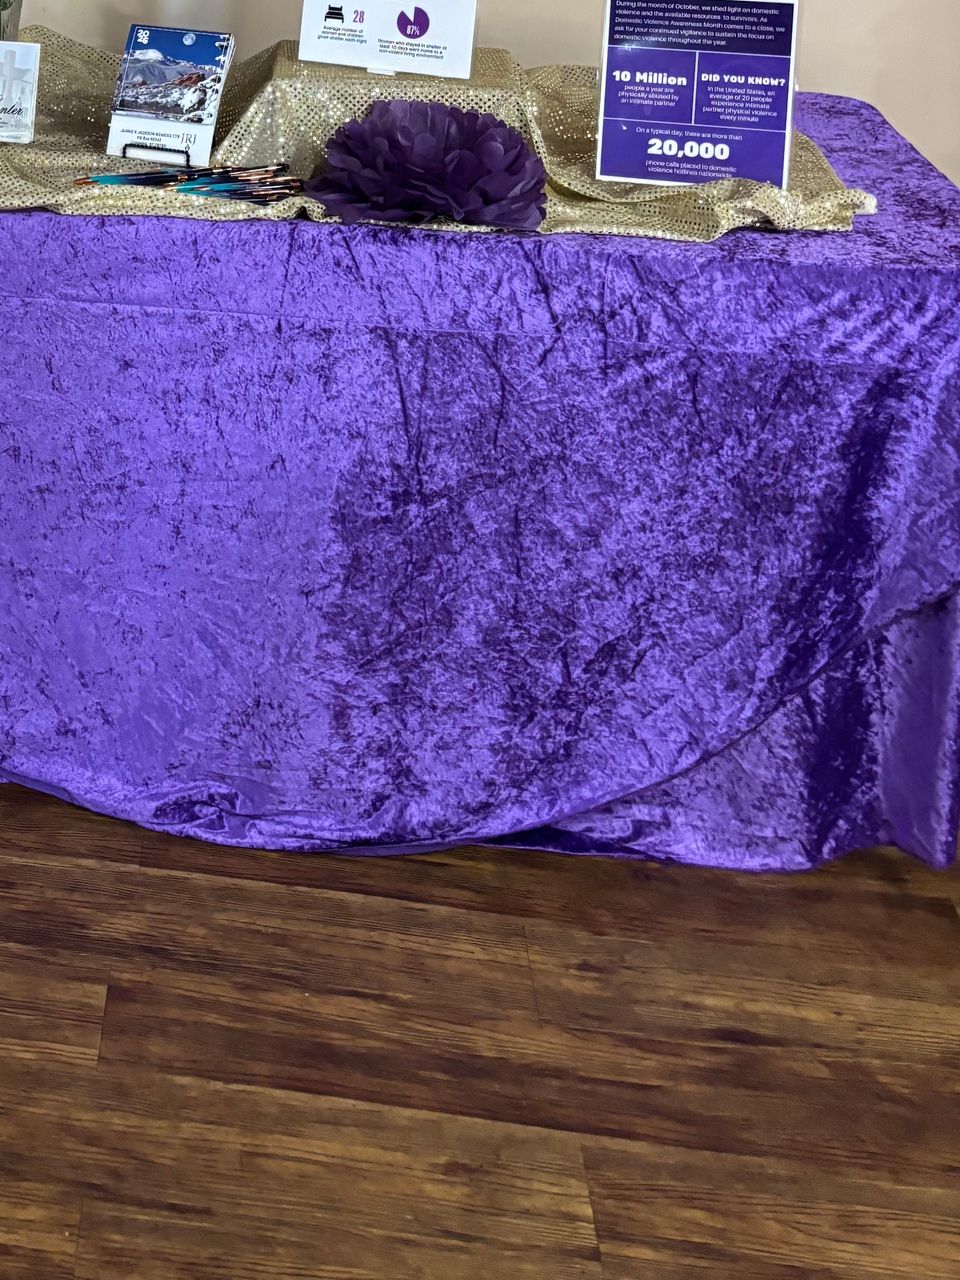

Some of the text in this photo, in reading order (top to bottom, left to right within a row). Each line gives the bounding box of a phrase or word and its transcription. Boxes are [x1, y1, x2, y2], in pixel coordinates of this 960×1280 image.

[353, 10, 364, 23] 28
[138, 29, 149, 37] 20
[407, 25, 419, 35] 87%
[137, 36, 149, 44] 26
[613, 70, 687, 86] 10 Million
[701, 73, 785, 86] DID YOU KNOW?
[726, 107, 750, 115] physical
[181, 133, 197, 145] JRJ
[647, 138, 730, 160] 20,000
[674, 168, 697, 176] hotlines
[709, 164, 736, 172] domestic
